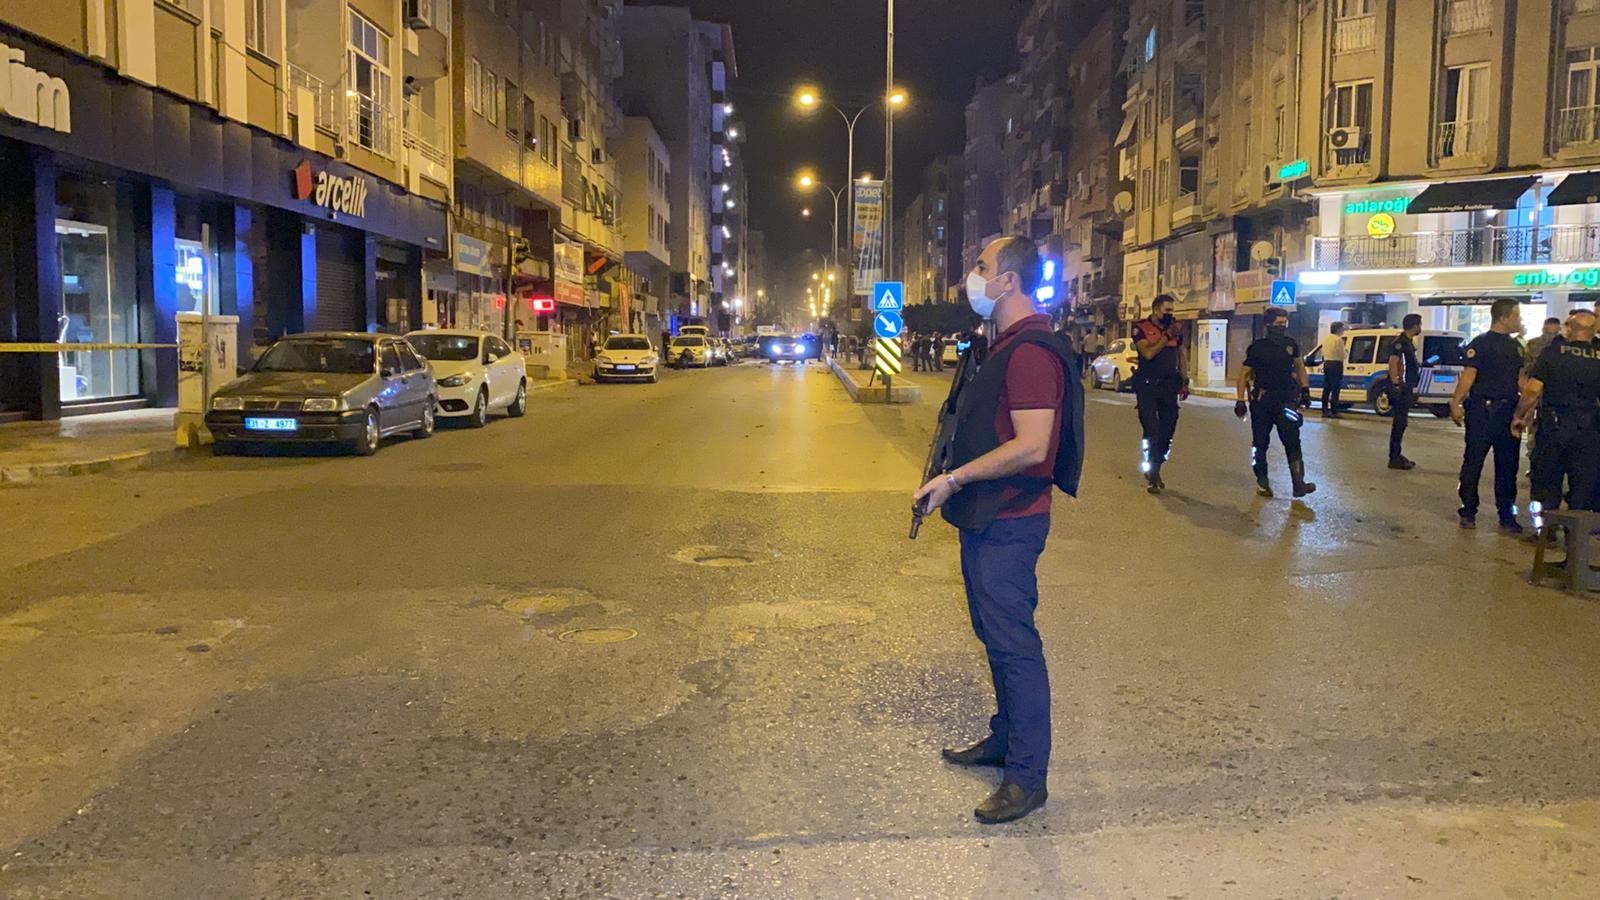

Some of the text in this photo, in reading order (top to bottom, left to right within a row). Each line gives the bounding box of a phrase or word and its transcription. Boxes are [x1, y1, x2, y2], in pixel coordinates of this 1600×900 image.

[315, 170, 367, 220] arçelik
[1345, 196, 1410, 214] anlaroğl
[1514, 267, 1600, 287] anlaroğ
